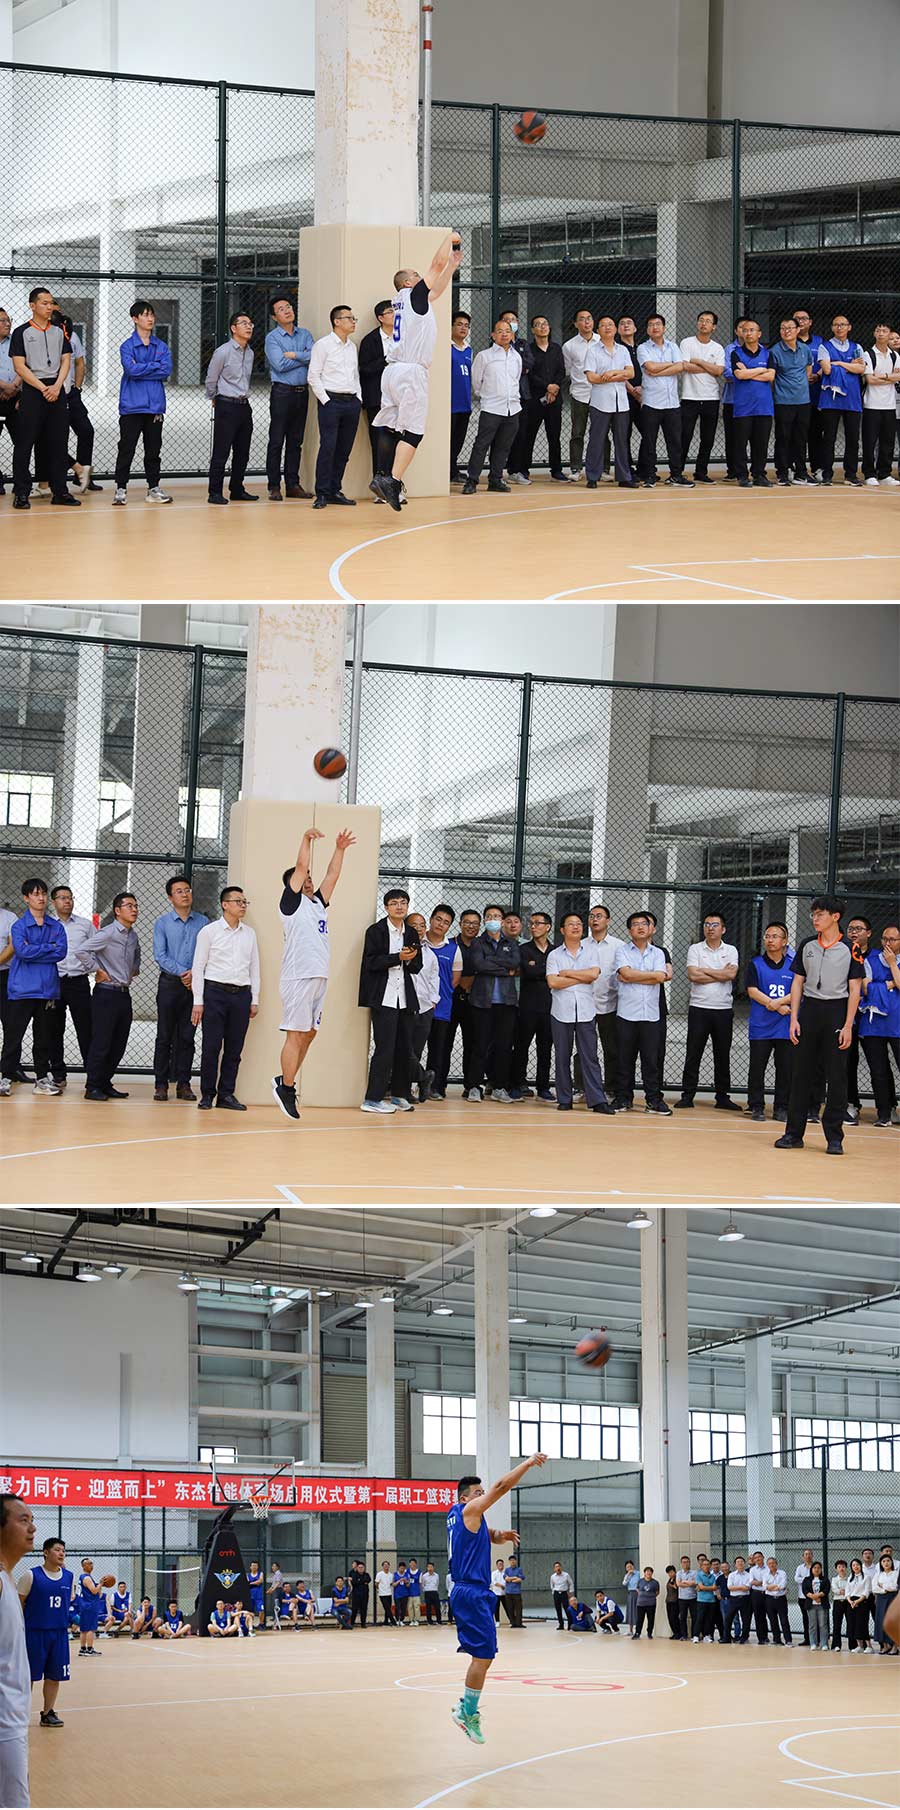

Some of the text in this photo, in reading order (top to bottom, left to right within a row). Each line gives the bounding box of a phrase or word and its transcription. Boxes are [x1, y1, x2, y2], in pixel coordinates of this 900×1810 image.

[393, 315, 401, 342] 9
[769, 983, 785, 997] 26
[49, 1596, 62, 1608] 13
